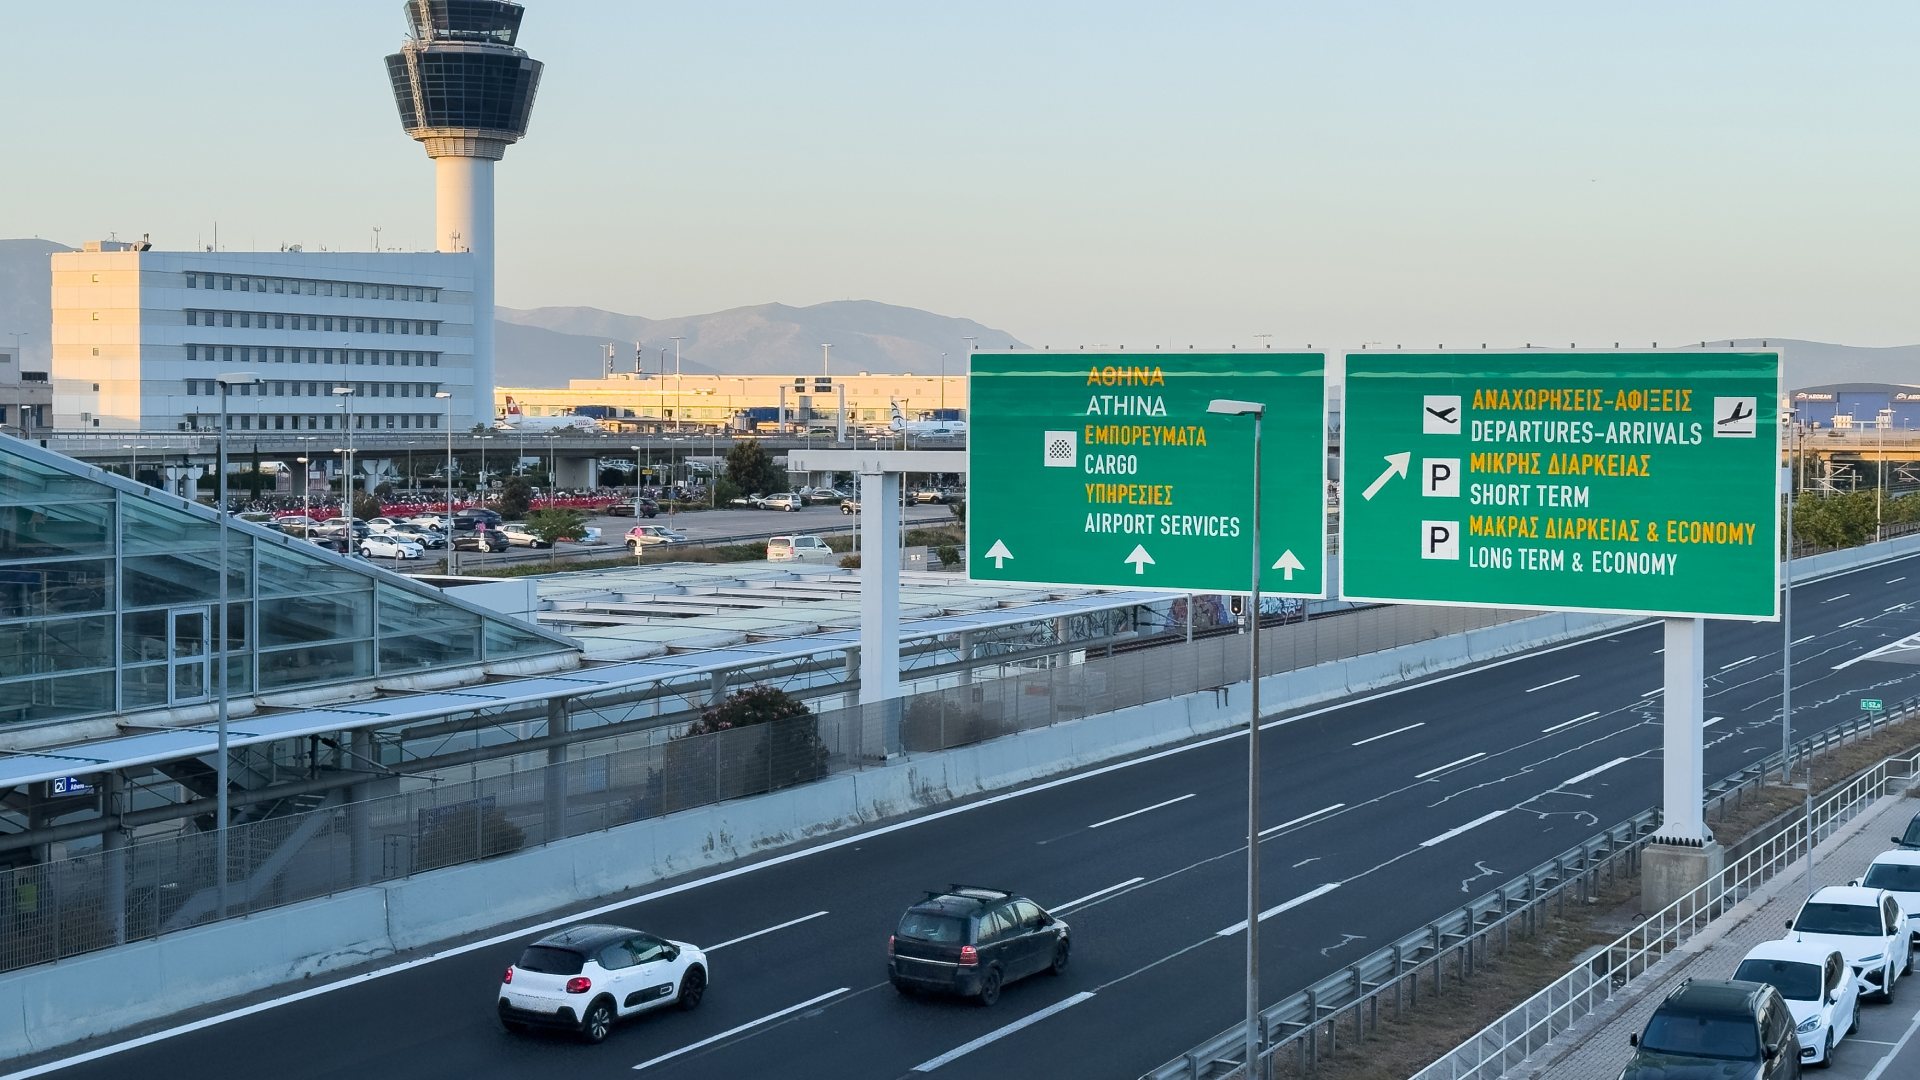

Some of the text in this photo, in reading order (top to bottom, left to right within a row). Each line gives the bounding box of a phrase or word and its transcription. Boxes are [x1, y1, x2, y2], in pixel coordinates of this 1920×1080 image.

[1087, 366, 1165, 386] ΑΘΗΝΑ
[1086, 396, 1167, 416] ATHINA
[1084, 425, 1207, 446] ΕΜΠΟΡΕΥΜΑΤΑ
[1471, 421, 1702, 445] DEPARTURES-ARRIVALS
[1085, 454, 1137, 475] CARGO
[1470, 453, 1650, 477] ΜΙΚΡΗΣ ΔΙΑΡΚΕΙΑΣ
[1431, 464, 1451, 491] P
[1085, 484, 1173, 506] ΥΠΗΡΕΣΙΕΣ
[1470, 484, 1589, 508] SHORT TERM
[1085, 513, 1240, 538] AIRPORT SERVICES
[1469, 515, 1756, 546] ΜΑΚΡΑΣ ΔΙΑΡΚΕΙΑΣ & ECONOMY
[1430, 526, 1449, 553] P
[1469, 547, 1678, 576] LONG TERM & ECONOMY
